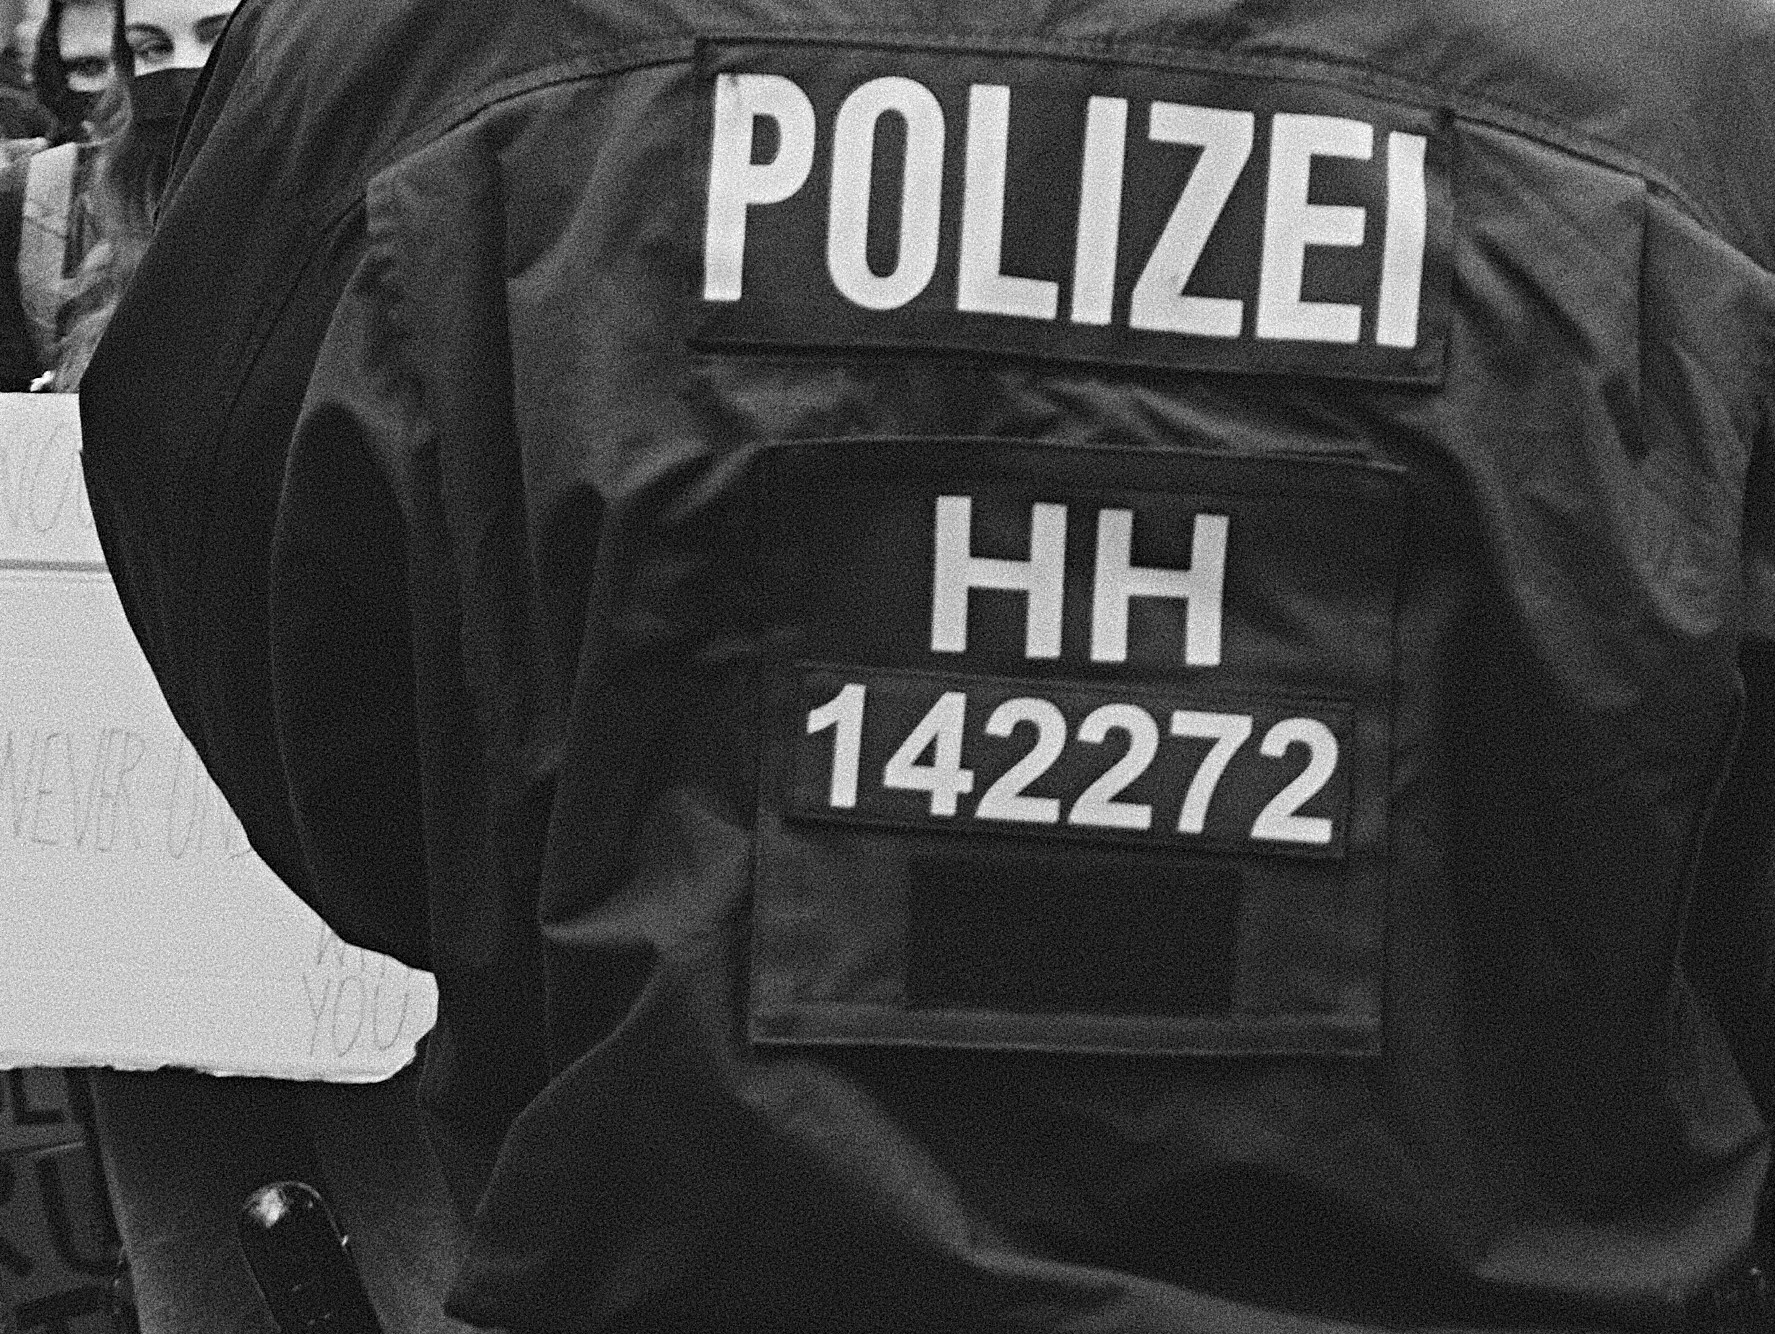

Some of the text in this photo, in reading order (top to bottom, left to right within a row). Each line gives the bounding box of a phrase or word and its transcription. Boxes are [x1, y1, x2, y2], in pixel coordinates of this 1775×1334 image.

[703, 73, 1428, 349] POLIZEI
[930, 495, 1230, 668] HH
[806, 682, 1340, 845] 142272
[301, 971, 411, 1059] YOU
